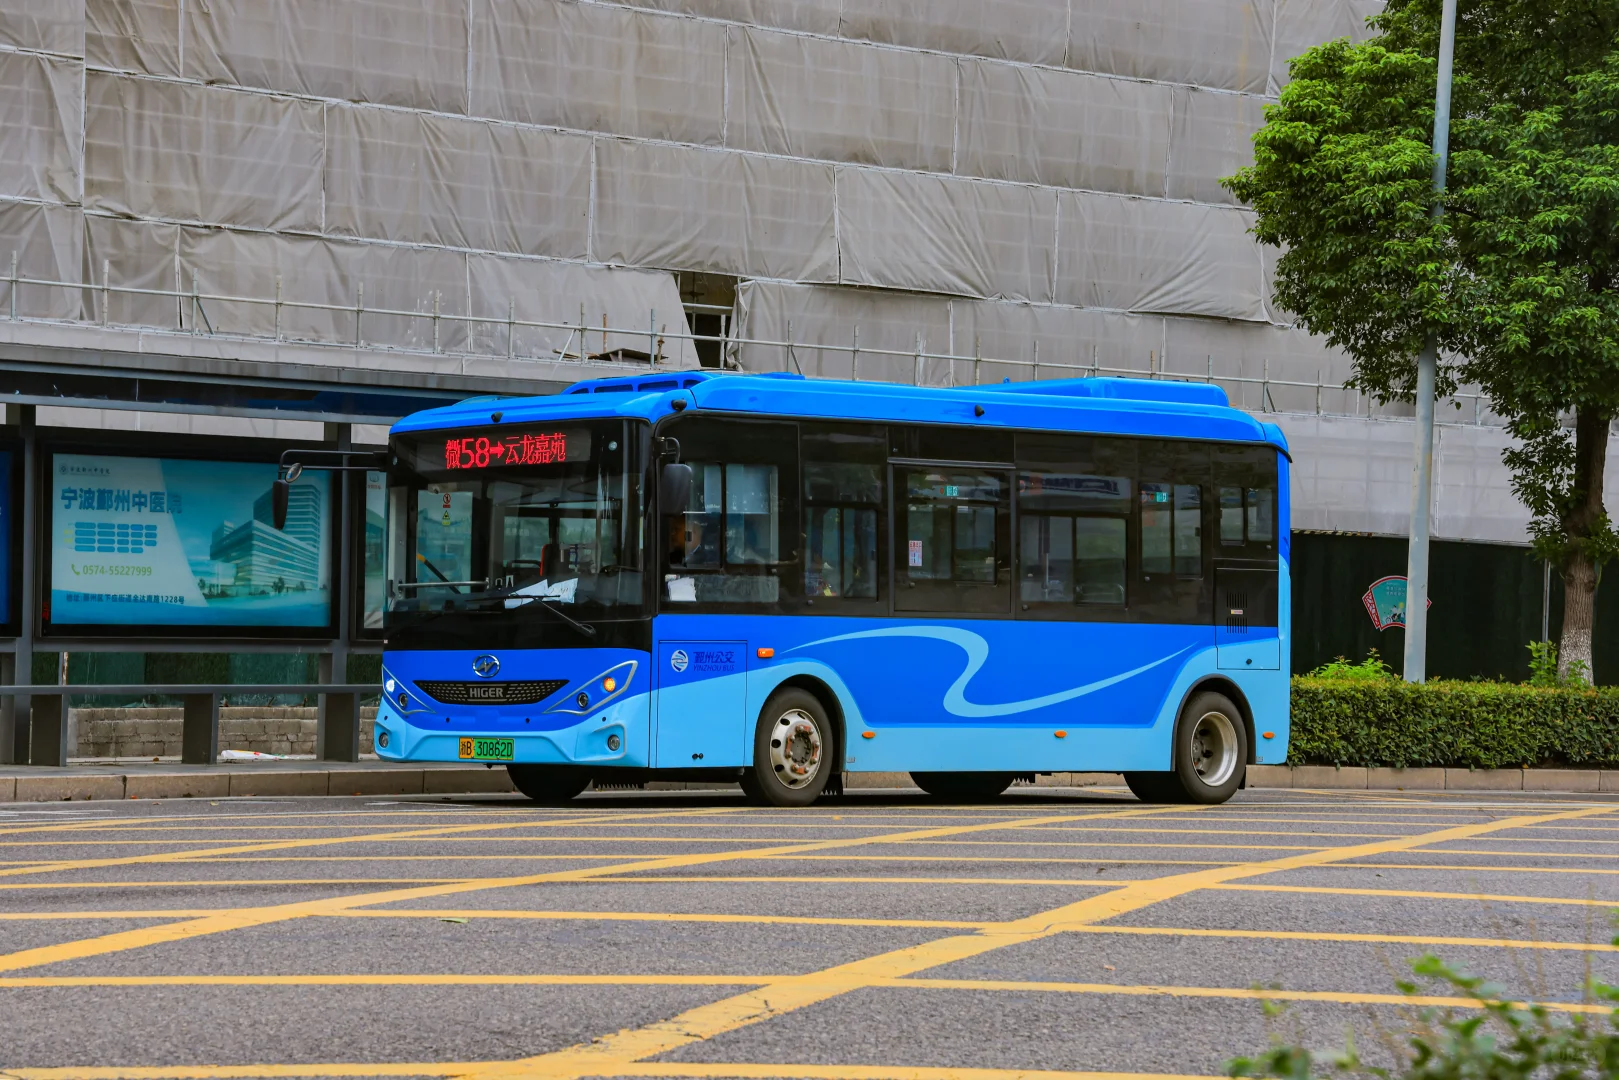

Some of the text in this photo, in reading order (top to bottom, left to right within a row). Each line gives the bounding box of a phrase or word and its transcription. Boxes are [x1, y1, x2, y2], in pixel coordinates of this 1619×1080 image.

[505, 432, 566, 464] 云龙嘉苑
[61, 486, 183, 514] 宁波鄞州中医院
[82, 564, 152, 576] 0574-55227999
[693, 651, 735, 664] 鄞州公交
[693, 664, 735, 672] YINZHOU BUS
[469, 687, 504, 698] HIGER
